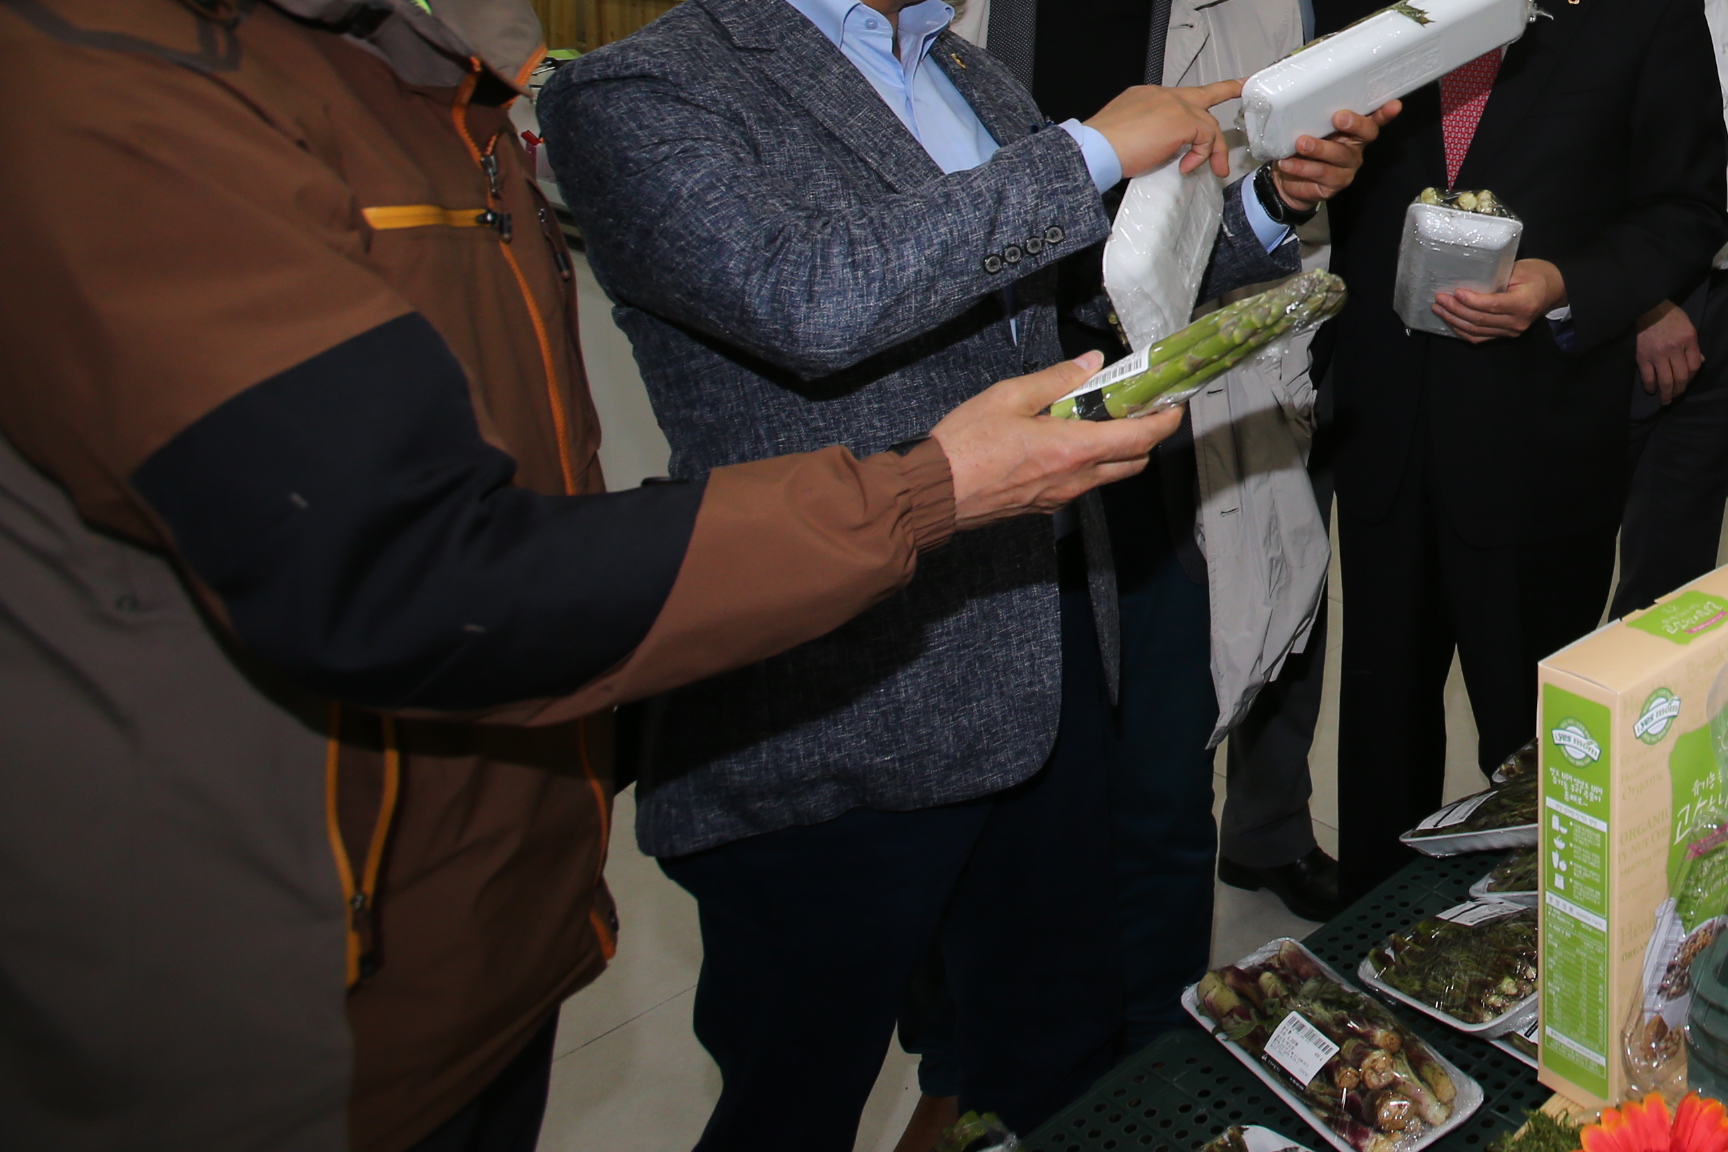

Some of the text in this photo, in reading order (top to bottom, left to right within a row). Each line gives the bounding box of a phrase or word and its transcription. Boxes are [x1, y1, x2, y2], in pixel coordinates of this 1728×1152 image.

[1640, 703, 1678, 732] yes mom
[1557, 731, 1598, 758] yes mom
